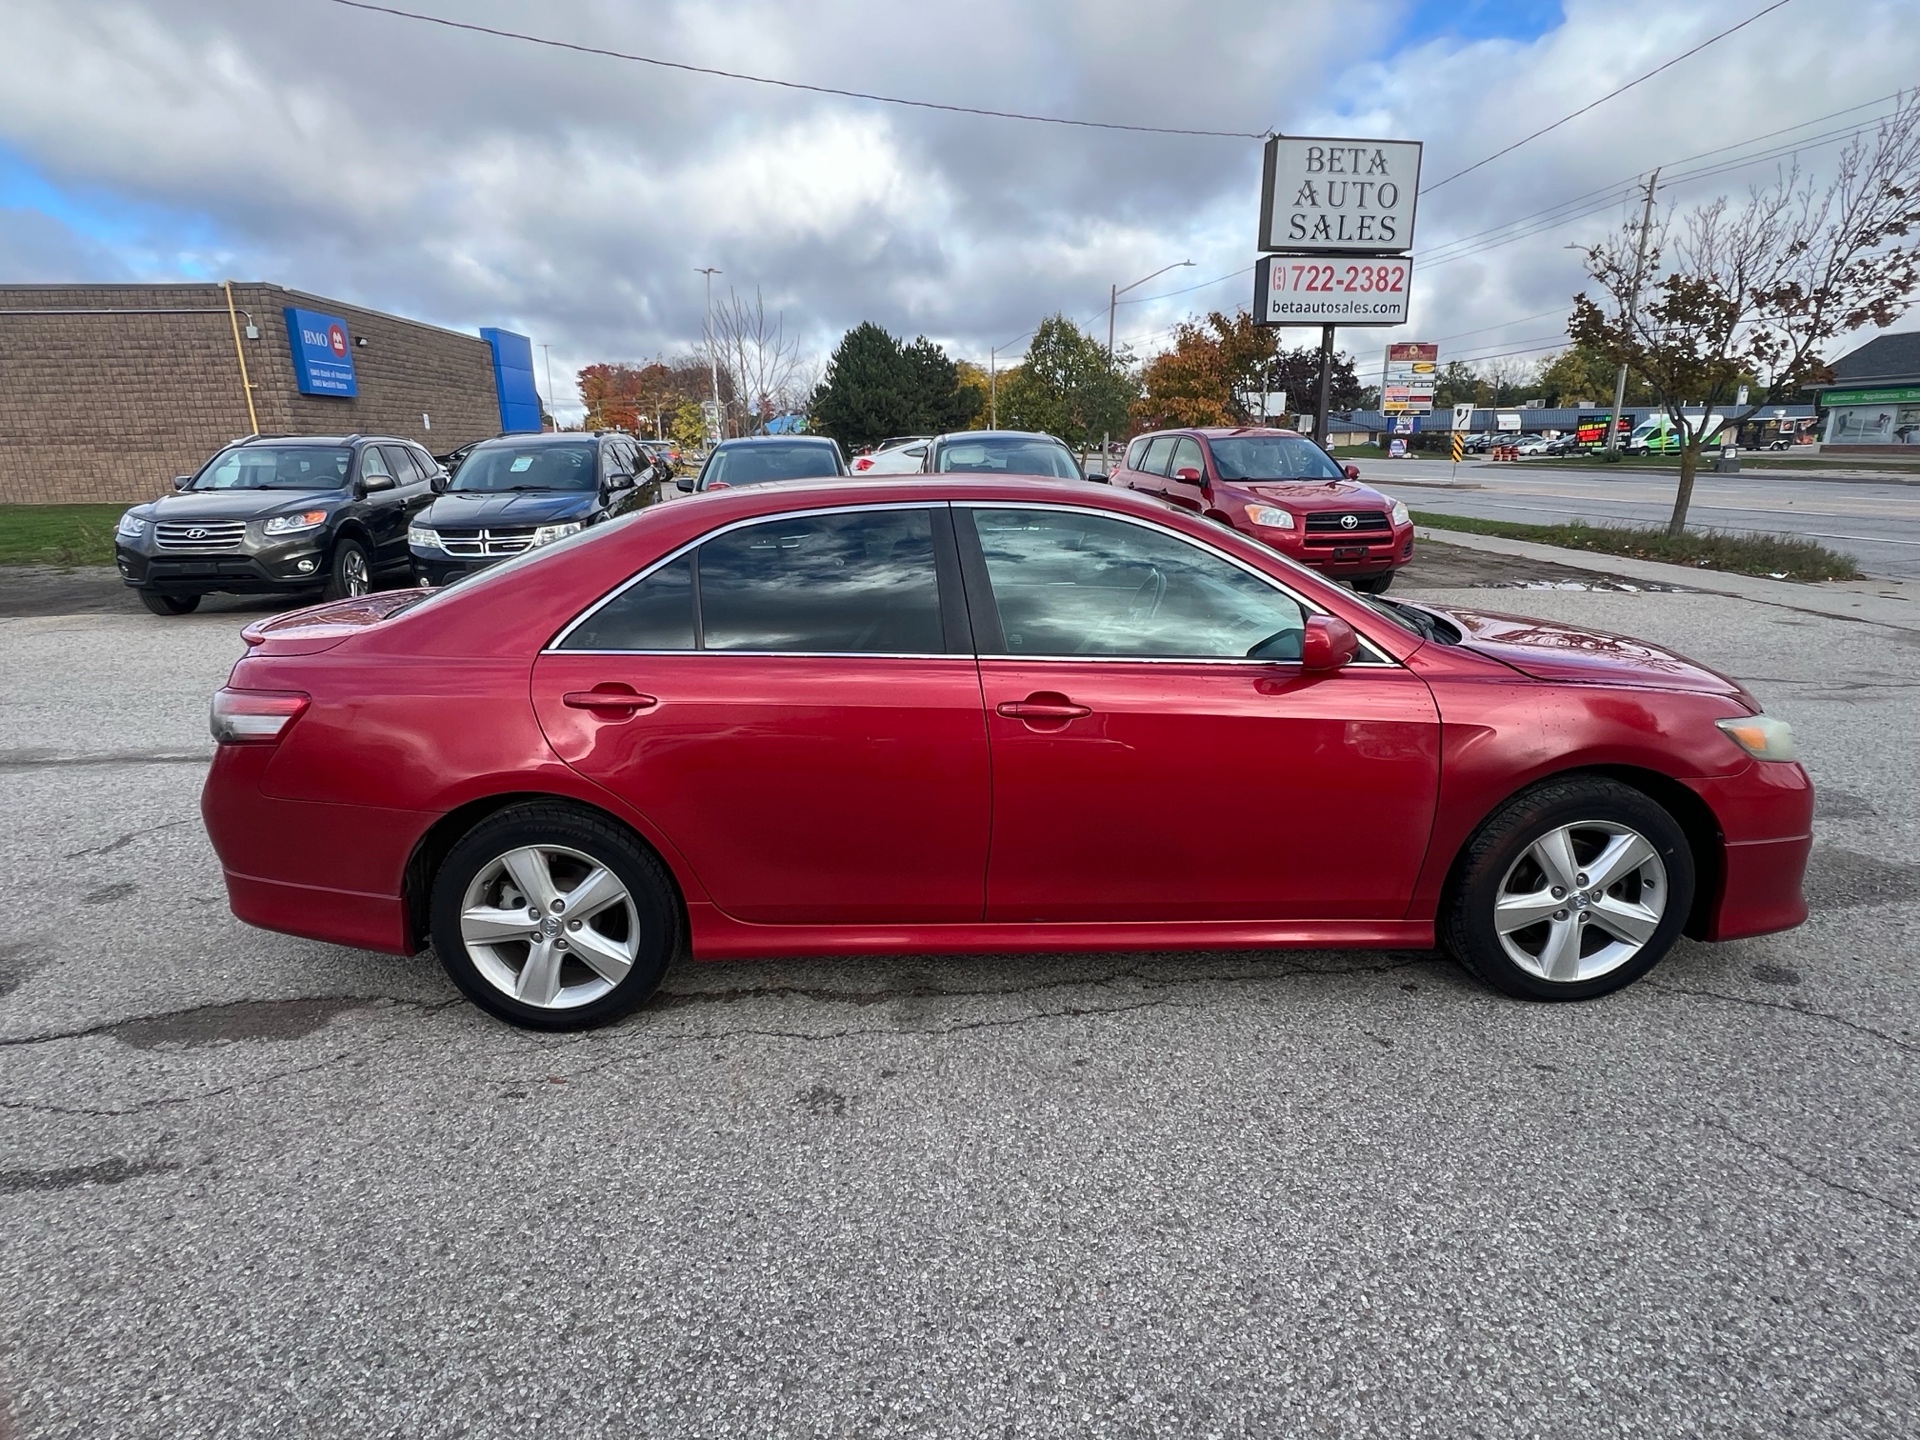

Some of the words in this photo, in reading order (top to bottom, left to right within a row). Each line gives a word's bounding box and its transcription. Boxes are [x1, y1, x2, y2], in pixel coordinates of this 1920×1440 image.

[1306, 146, 1389, 176] BETA
[1292, 180, 1400, 209] AUTO
[1288, 213, 1397, 243] SALES
[1291, 265, 1404, 292] 722-2382
[1272, 300, 1401, 314] betaautosales.com
[303, 329, 328, 347] BMO
